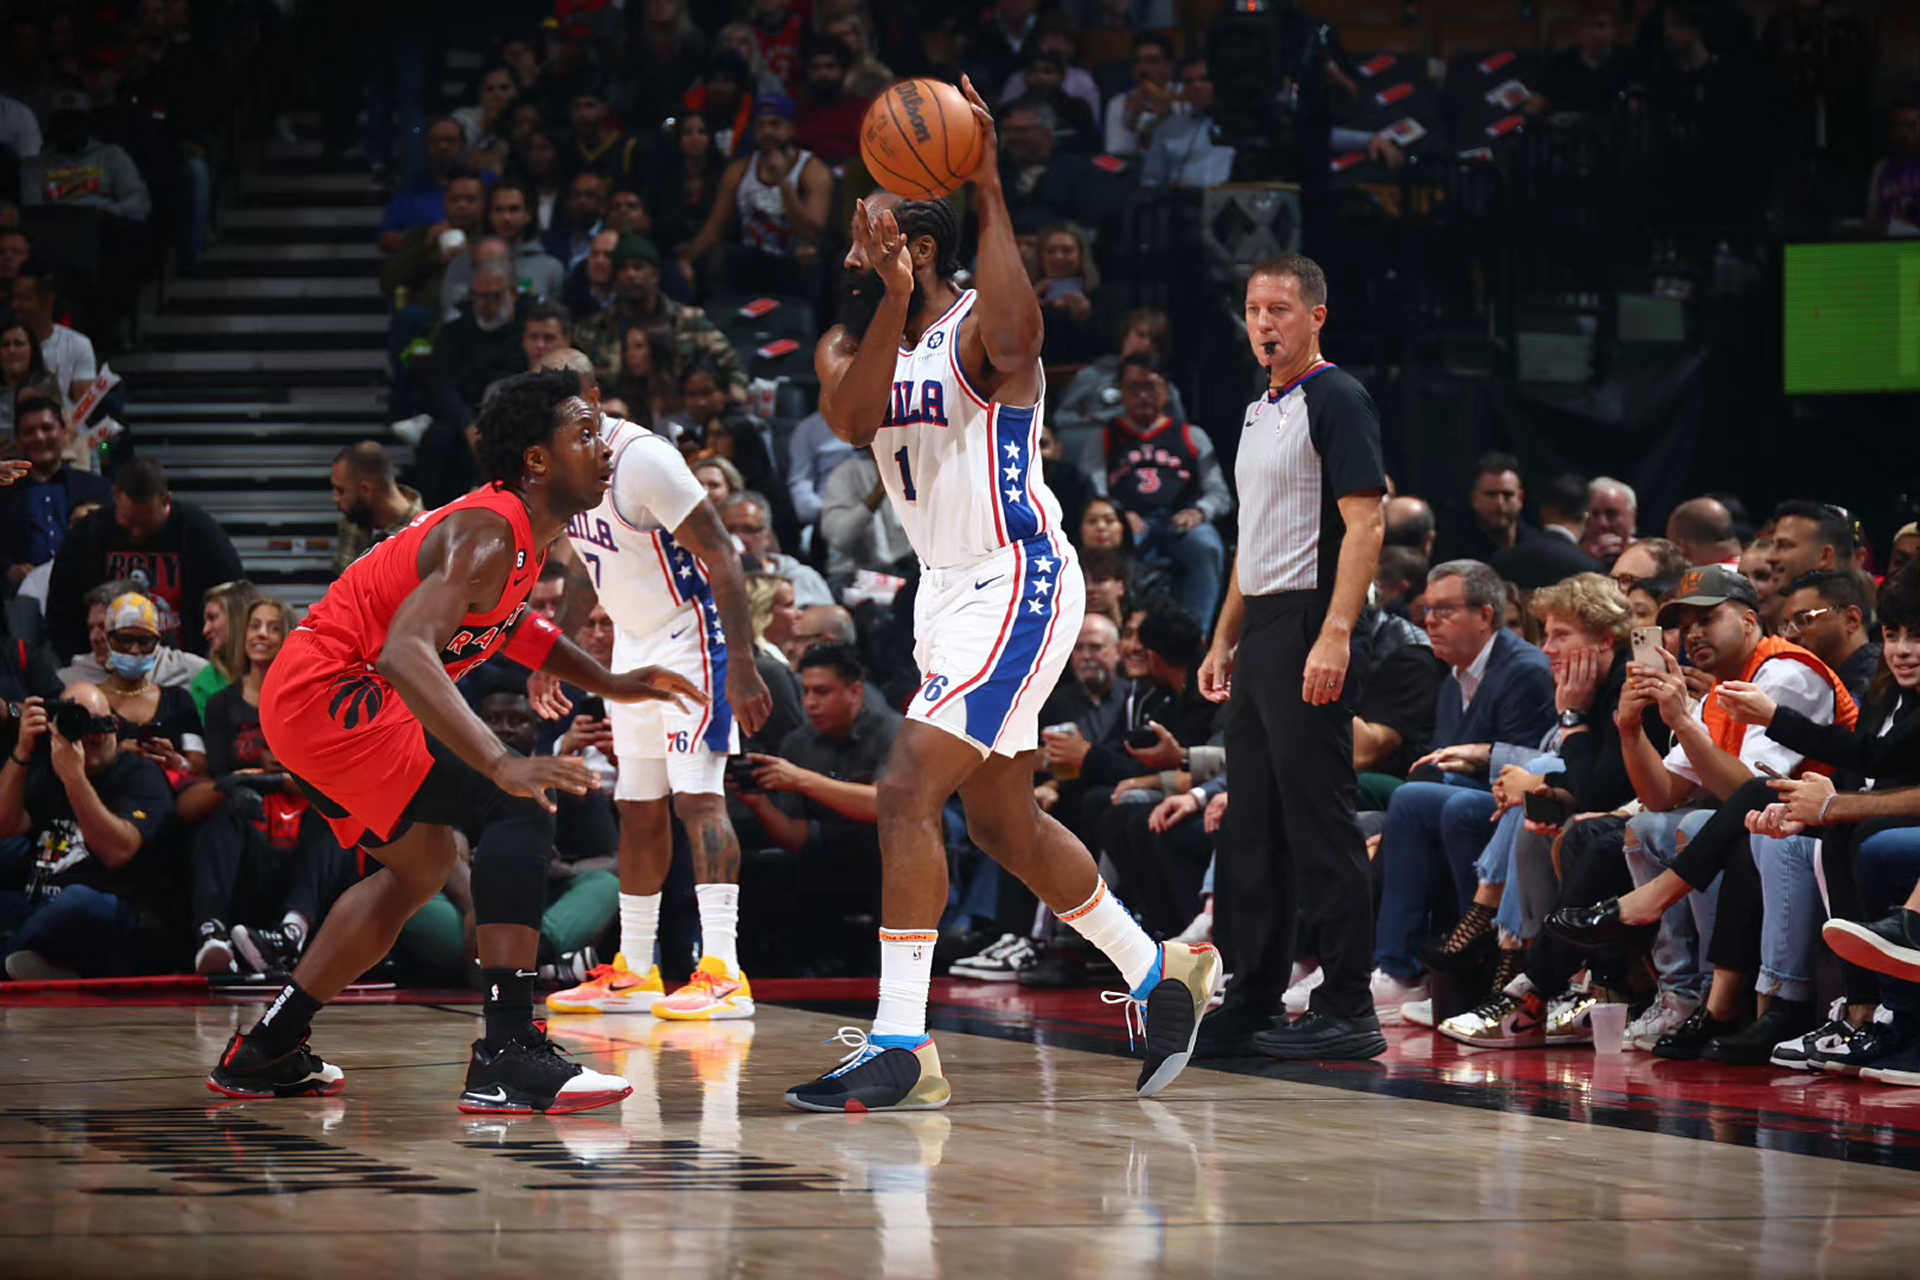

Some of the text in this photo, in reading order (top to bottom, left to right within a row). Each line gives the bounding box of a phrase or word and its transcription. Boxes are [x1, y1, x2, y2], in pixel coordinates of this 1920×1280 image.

[894, 80, 932, 144] Wilson
[878, 379, 949, 428] ILA
[894, 445, 917, 502] 1
[1135, 467, 1161, 494] 3
[582, 549, 601, 590] 7
[667, 730, 689, 753] 76
